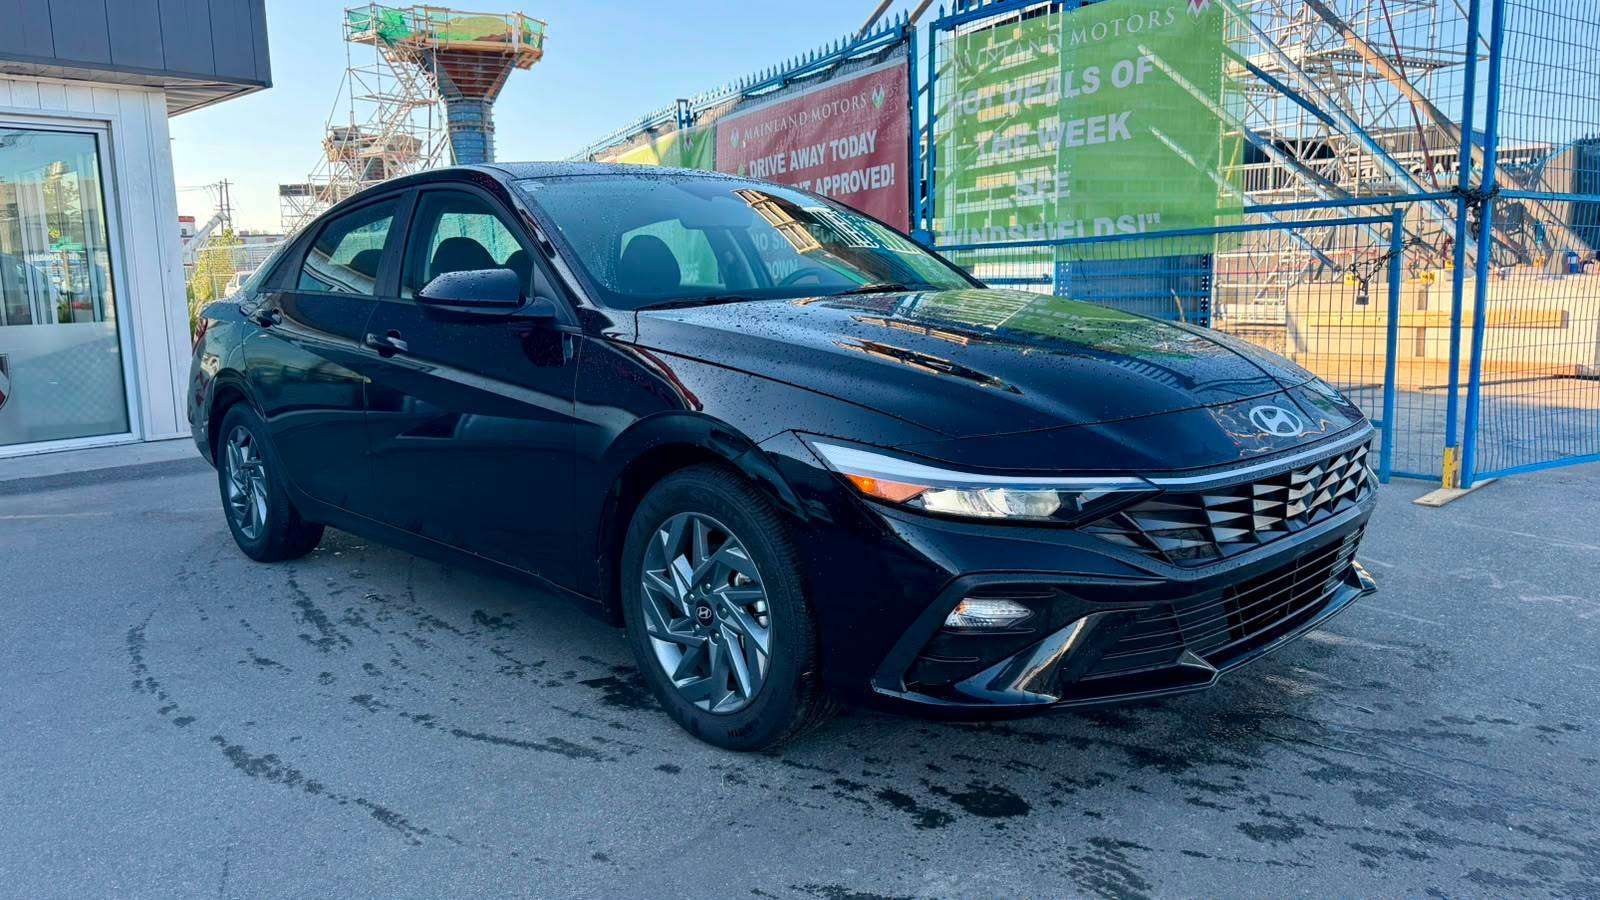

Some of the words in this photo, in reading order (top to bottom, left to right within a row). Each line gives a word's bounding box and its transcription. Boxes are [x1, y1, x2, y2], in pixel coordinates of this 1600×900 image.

[1070, 6, 1176, 46] MOTORS
[1003, 65, 1101, 106] DEALS
[1111, 55, 1155, 89] OF
[744, 111, 807, 140] MAINLAND
[811, 91, 867, 121] MOTORS
[1037, 110, 1133, 152] WEEK
[750, 152, 787, 178] DRIVE
[790, 142, 826, 172] AWAY
[829, 128, 878, 163] TODAY
[815, 163, 896, 197] APPROVED!
